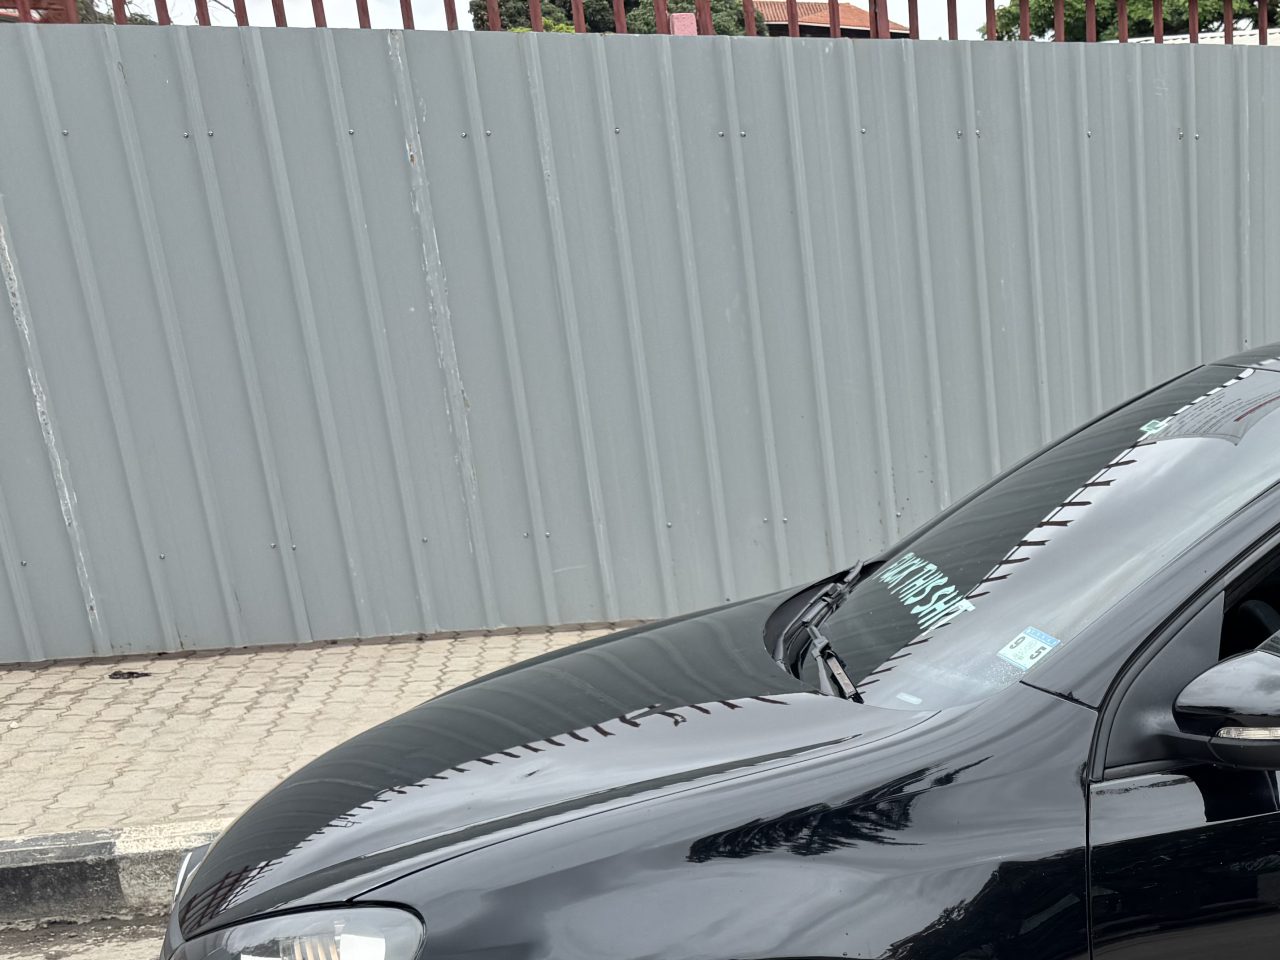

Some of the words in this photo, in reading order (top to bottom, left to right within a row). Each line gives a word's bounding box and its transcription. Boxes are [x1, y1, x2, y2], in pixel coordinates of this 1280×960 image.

[890, 563, 949, 606] THIS
[910, 585, 976, 636] SHIT
[1009, 636, 1026, 650] 9
[1029, 646, 1048, 660] 5
